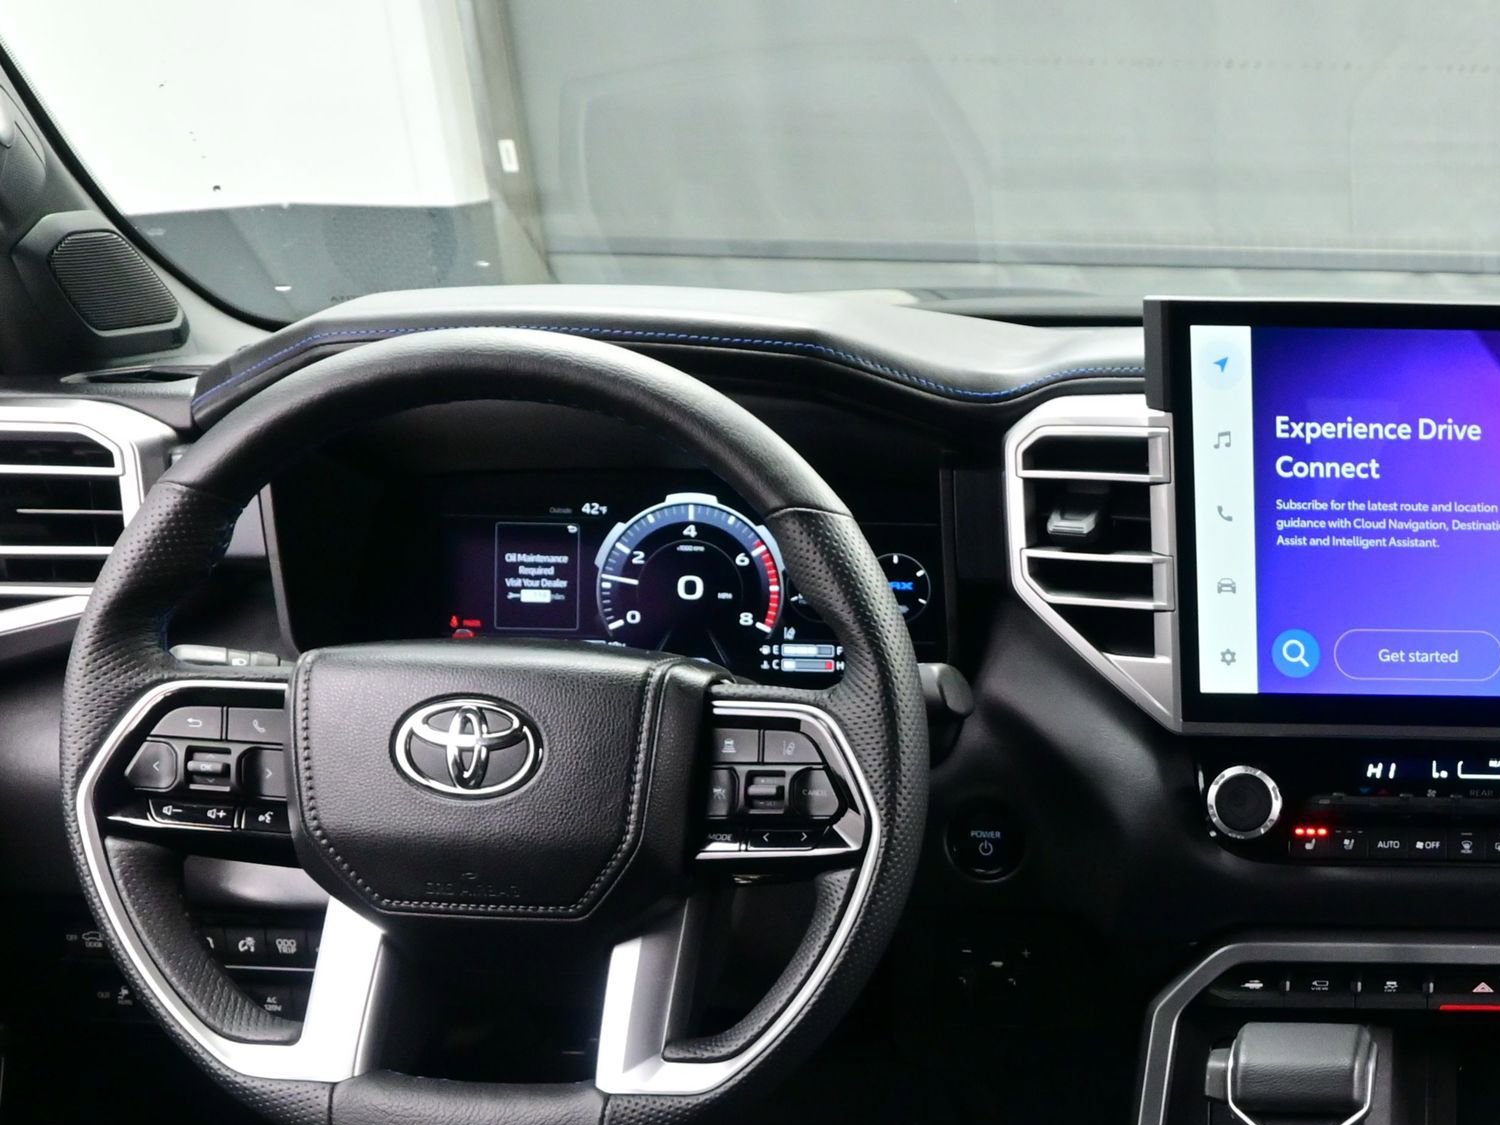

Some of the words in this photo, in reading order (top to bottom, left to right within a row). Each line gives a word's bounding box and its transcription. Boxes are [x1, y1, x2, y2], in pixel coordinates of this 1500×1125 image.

[1275, 415, 1412, 444] Experience
[1418, 417, 1482, 441] Drive
[1275, 455, 1380, 479] Connect
[1276, 499, 1328, 512] Subscribe
[1330, 500, 1346, 512] for
[1347, 500, 1366, 512] the
[1367, 500, 1398, 513] latest
[1400, 502, 1430, 513] route
[1431, 501, 1453, 513] and
[1454, 501, 1499, 514] location
[681, 524, 698, 538] 4
[1276, 517, 1327, 531] guidance
[1328, 518, 1352, 530] with
[1353, 518, 1387, 530] Cloud
[1388, 519, 1449, 533] Navigation,
[1276, 534, 1307, 547] Assist
[1308, 535, 1330, 548] and
[1332, 535, 1387, 551] Intelligent
[1388, 536, 1440, 550] Assistant.
[505, 553, 517, 563] Oil
[517, 553, 569, 564] Maintenance
[631, 551, 646, 565] 2
[735, 552, 751, 566] 6
[518, 566, 555, 577] Required
[505, 578, 522, 588] Visit
[522, 578, 541, 588] Your
[541, 578, 568, 588] Dealer
[677, 575, 704, 601] 0
[626, 610, 642, 625] 0
[739, 612, 754, 626] 8
[772, 645, 780, 655] E
[836, 645, 844, 656] F
[1377, 648, 1406, 665] Get
[1408, 648, 1459, 666] started
[772, 660, 780, 670] C
[836, 660, 845, 671] H
[1469, 789, 1495, 798] REAR
[707, 833, 733, 842] MODE
[970, 829, 1002, 839] POWER
[1377, 840, 1400, 849] AUTO
[1425, 840, 1441, 849] OFF
